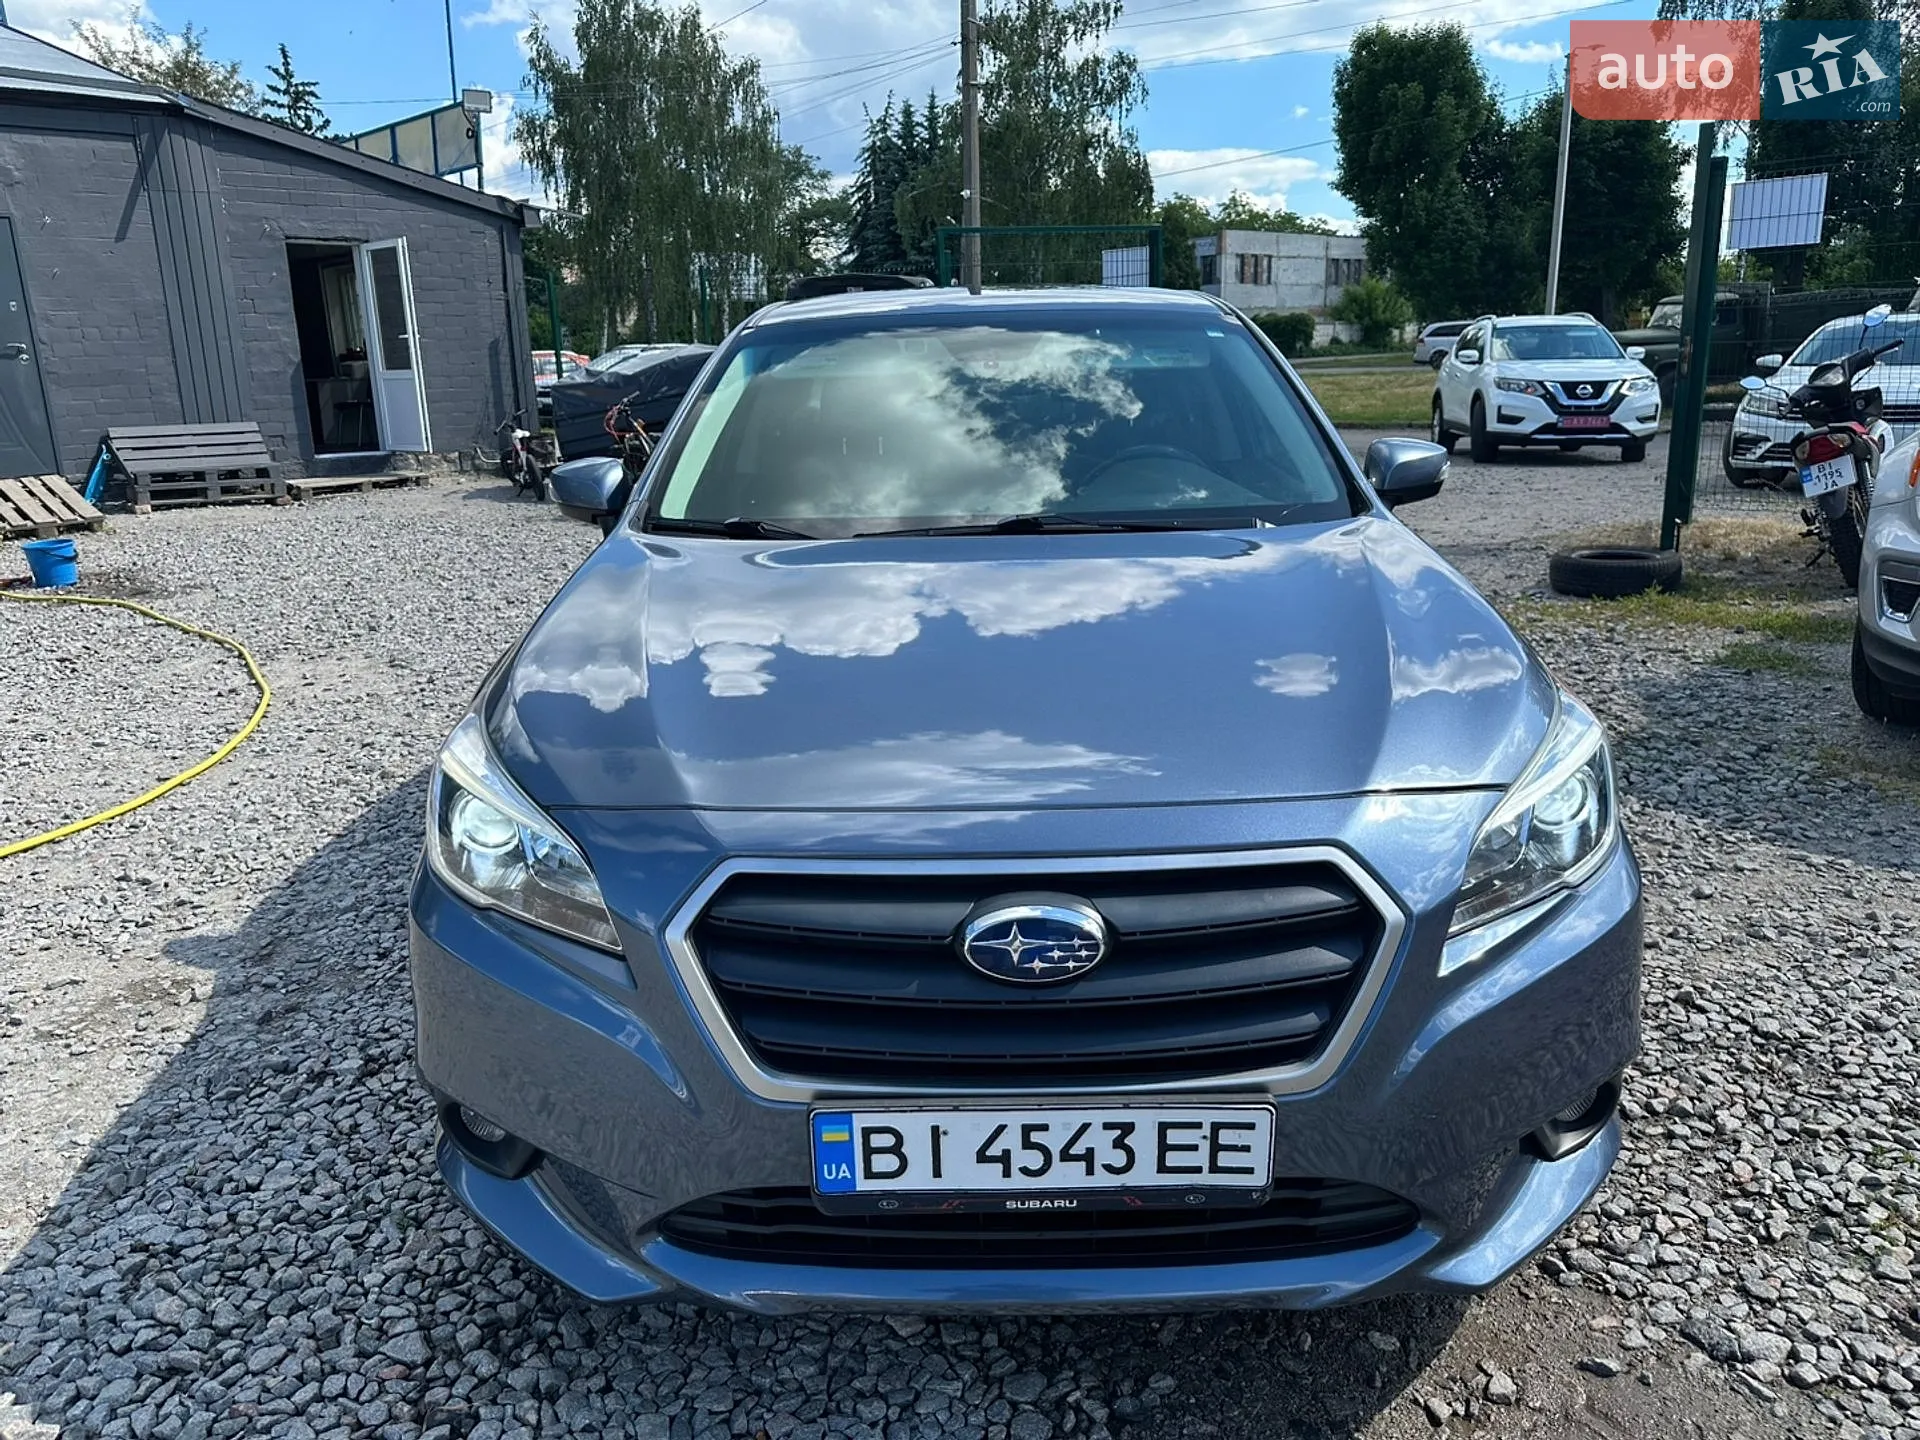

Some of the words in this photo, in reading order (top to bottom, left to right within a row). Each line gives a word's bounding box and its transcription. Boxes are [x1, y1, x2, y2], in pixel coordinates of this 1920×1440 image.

[1817, 462, 1832, 473] BI
[823, 1163, 851, 1180] UA
[975, 1121, 1136, 1179] 4543
[1156, 1121, 1256, 1175] EE
[1005, 1198, 1077, 1210] SUBARU
